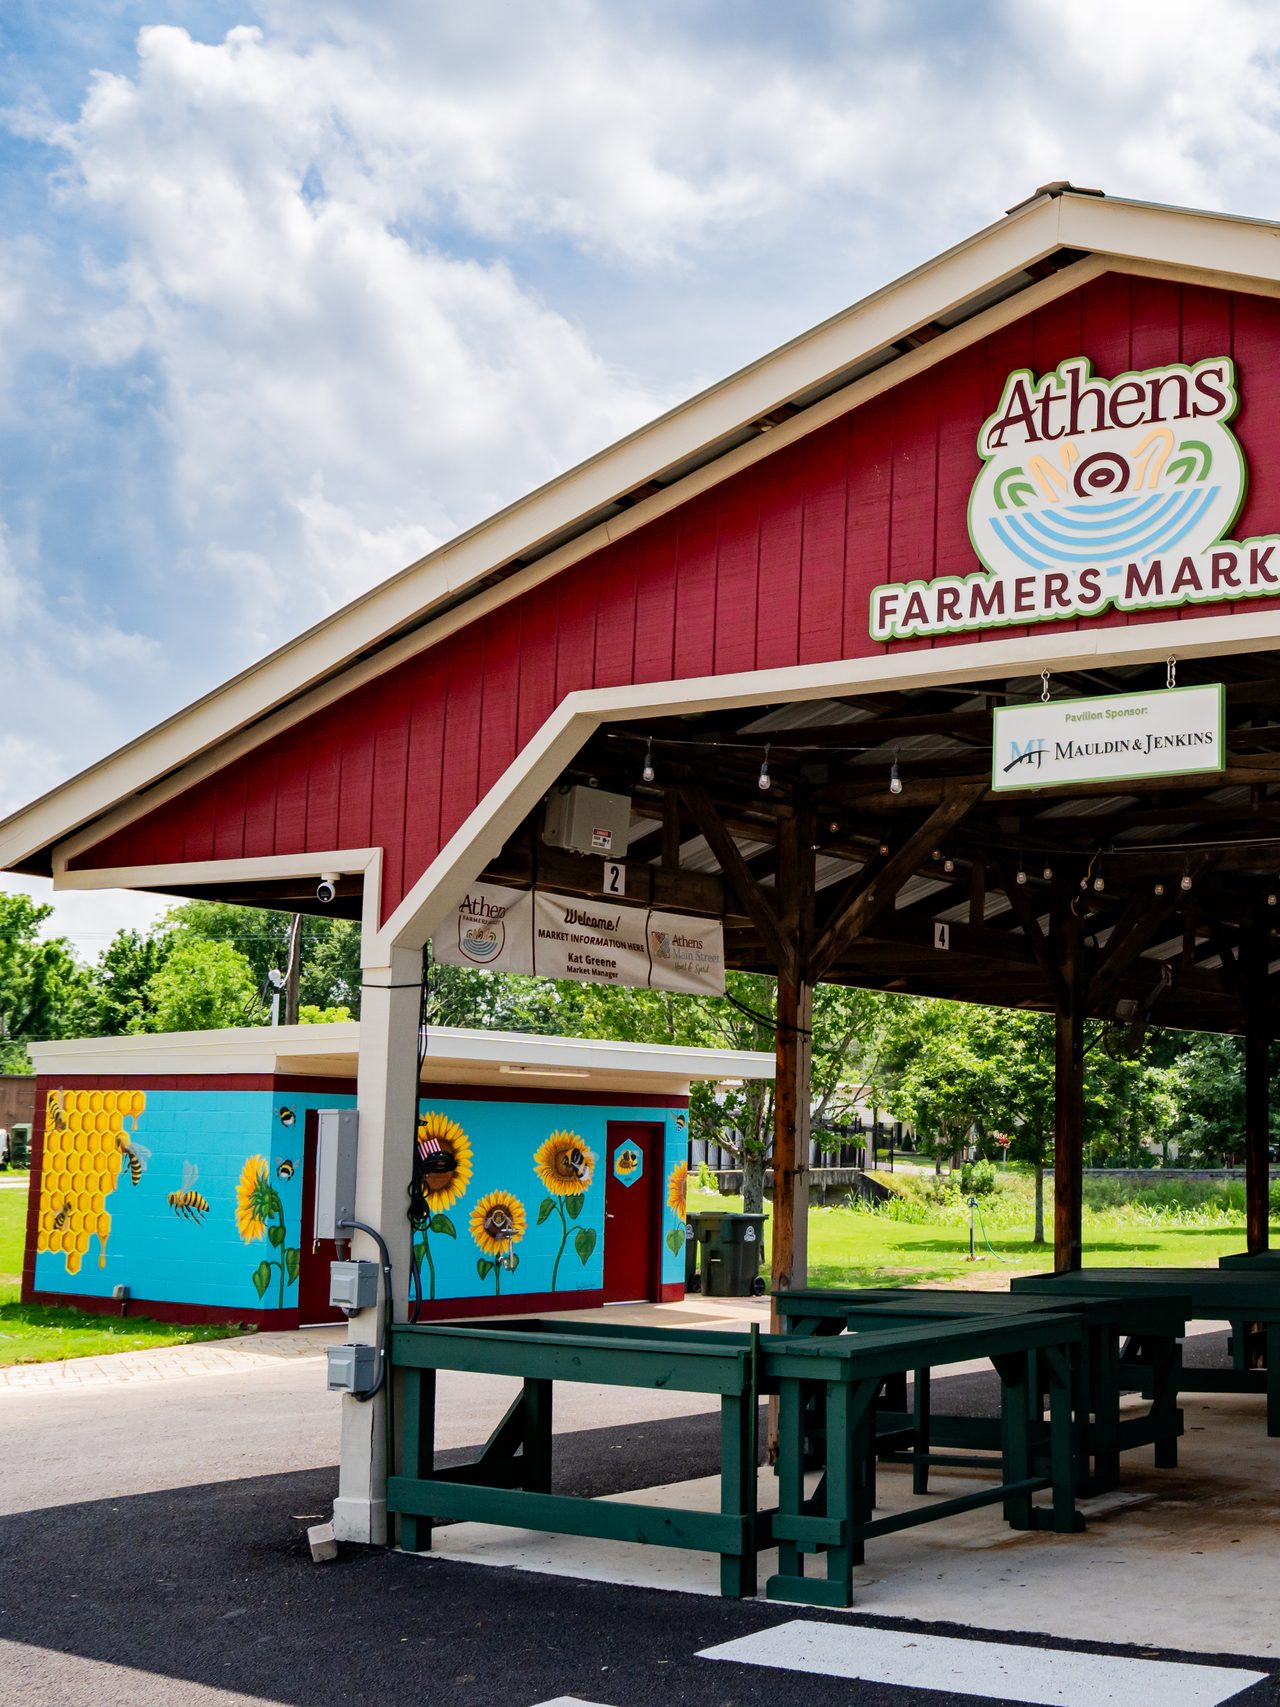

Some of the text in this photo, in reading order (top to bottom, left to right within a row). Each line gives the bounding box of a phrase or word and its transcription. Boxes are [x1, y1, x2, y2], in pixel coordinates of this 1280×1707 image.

[987, 367, 1227, 449] Athens
[878, 568, 1102, 630] FARMERS
[1065, 707, 1149, 723] Pavilion Sponsor:
[1055, 739, 1131, 760] MAULDIN
[1143, 731, 1213, 755] JENKINS
[610, 866, 620, 892] 2
[564, 908, 621, 932] Welcome!
[538, 929, 645, 953] MARKET INFORMATION HERE
[672, 933, 703, 950] Athens
[938, 925, 946, 947] 4
[568, 952, 617, 968] Kat Greene
[673, 948, 720, 963] Main Street
[566, 965, 619, 979] Market Manager
